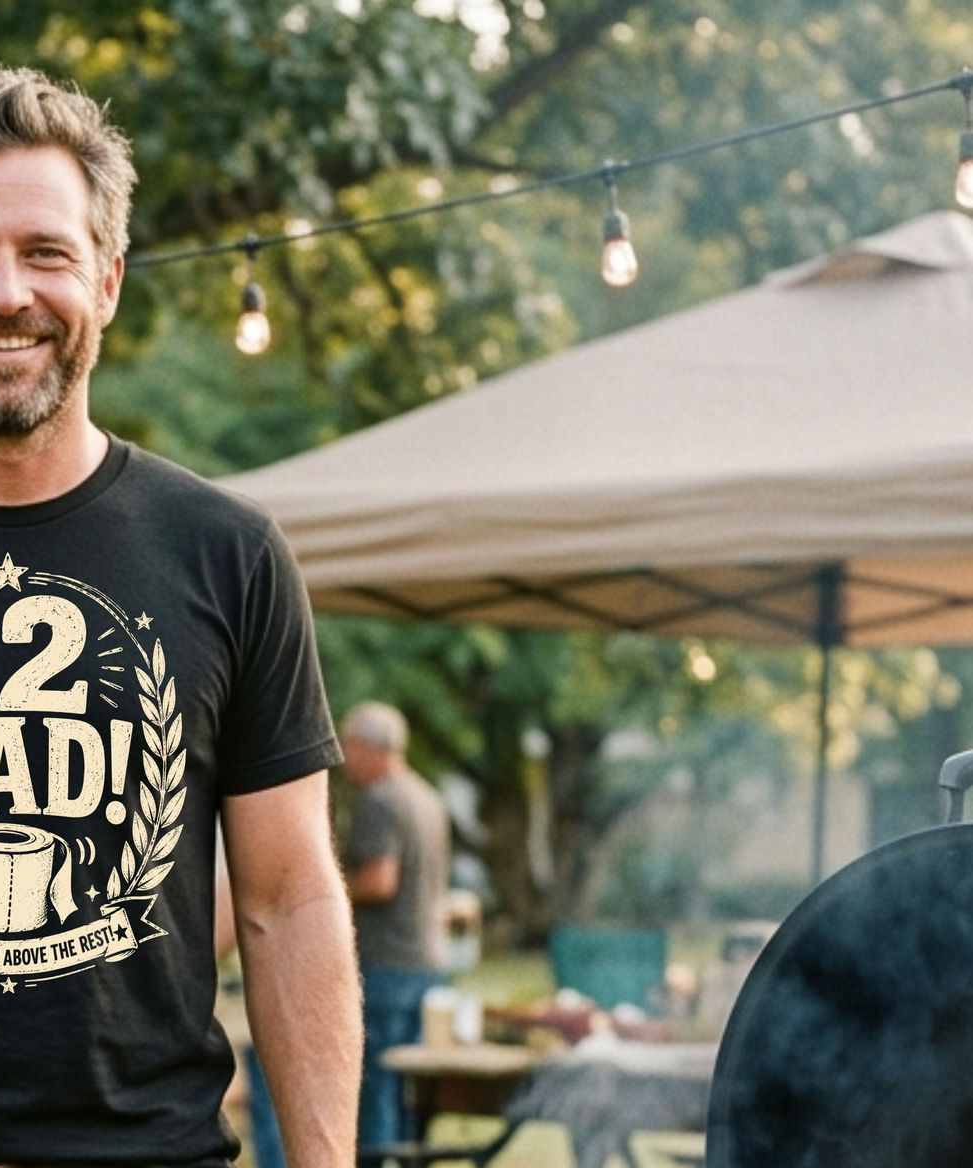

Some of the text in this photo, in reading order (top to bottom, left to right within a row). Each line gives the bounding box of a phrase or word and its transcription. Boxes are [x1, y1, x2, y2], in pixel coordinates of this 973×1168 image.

[3, 947, 48, 966] ABOVE
[50, 938, 78, 960] THE
[80, 925, 116, 951] REST!
